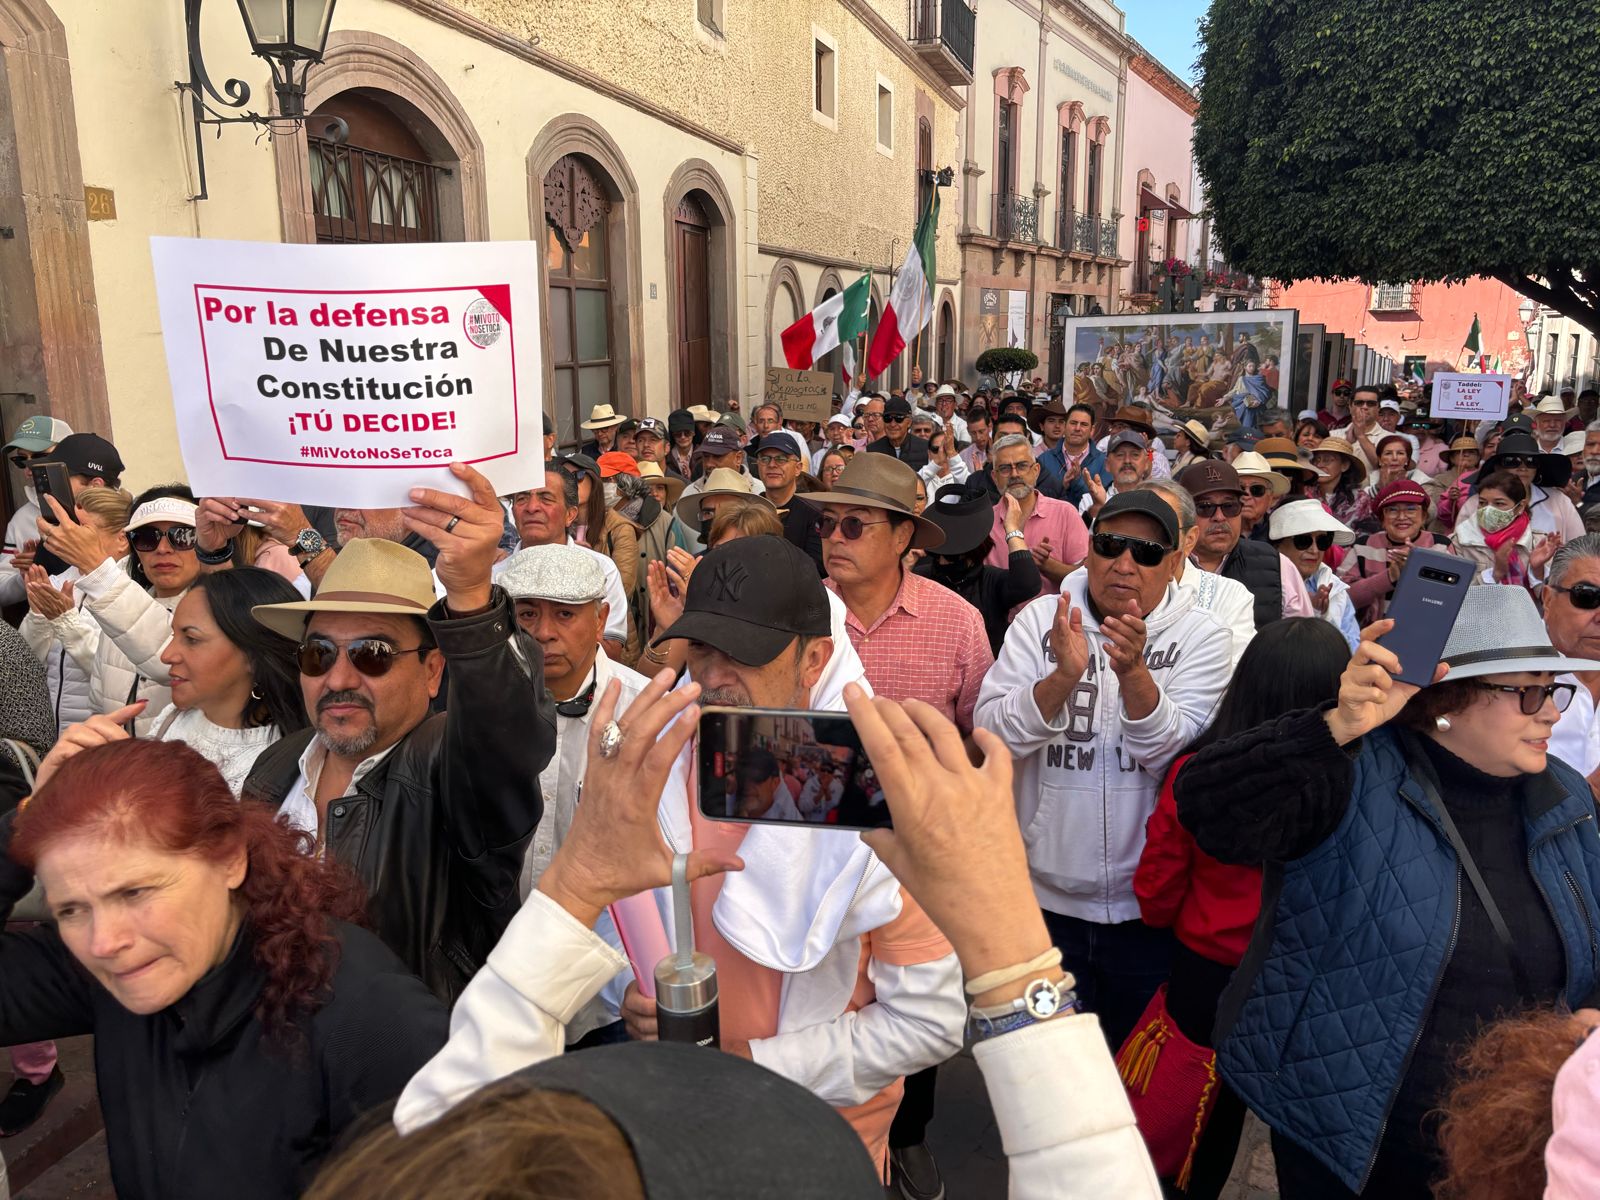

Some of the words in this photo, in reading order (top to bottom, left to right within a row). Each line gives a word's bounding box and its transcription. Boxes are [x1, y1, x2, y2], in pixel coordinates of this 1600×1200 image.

[88, 191, 110, 215] 26
[203, 297, 257, 325] Por
[268, 300, 298, 326] la
[310, 302, 450, 328] defensa
[469, 313, 500, 324] #MIVOTO
[470, 324, 501, 334] NOSETOCA
[264, 337, 308, 361] De
[321, 338, 458, 363] Nuestra
[257, 374, 473, 400] Constitución
[288, 409, 332, 435] ¡TÚ
[344, 411, 456, 432] DECIDE!
[300, 445, 453, 459] #MiVotoNoSeToca
[1206, 465, 1222, 482] LA
[707, 560, 749, 602] NY
[1047, 744, 1095, 771] NEW
